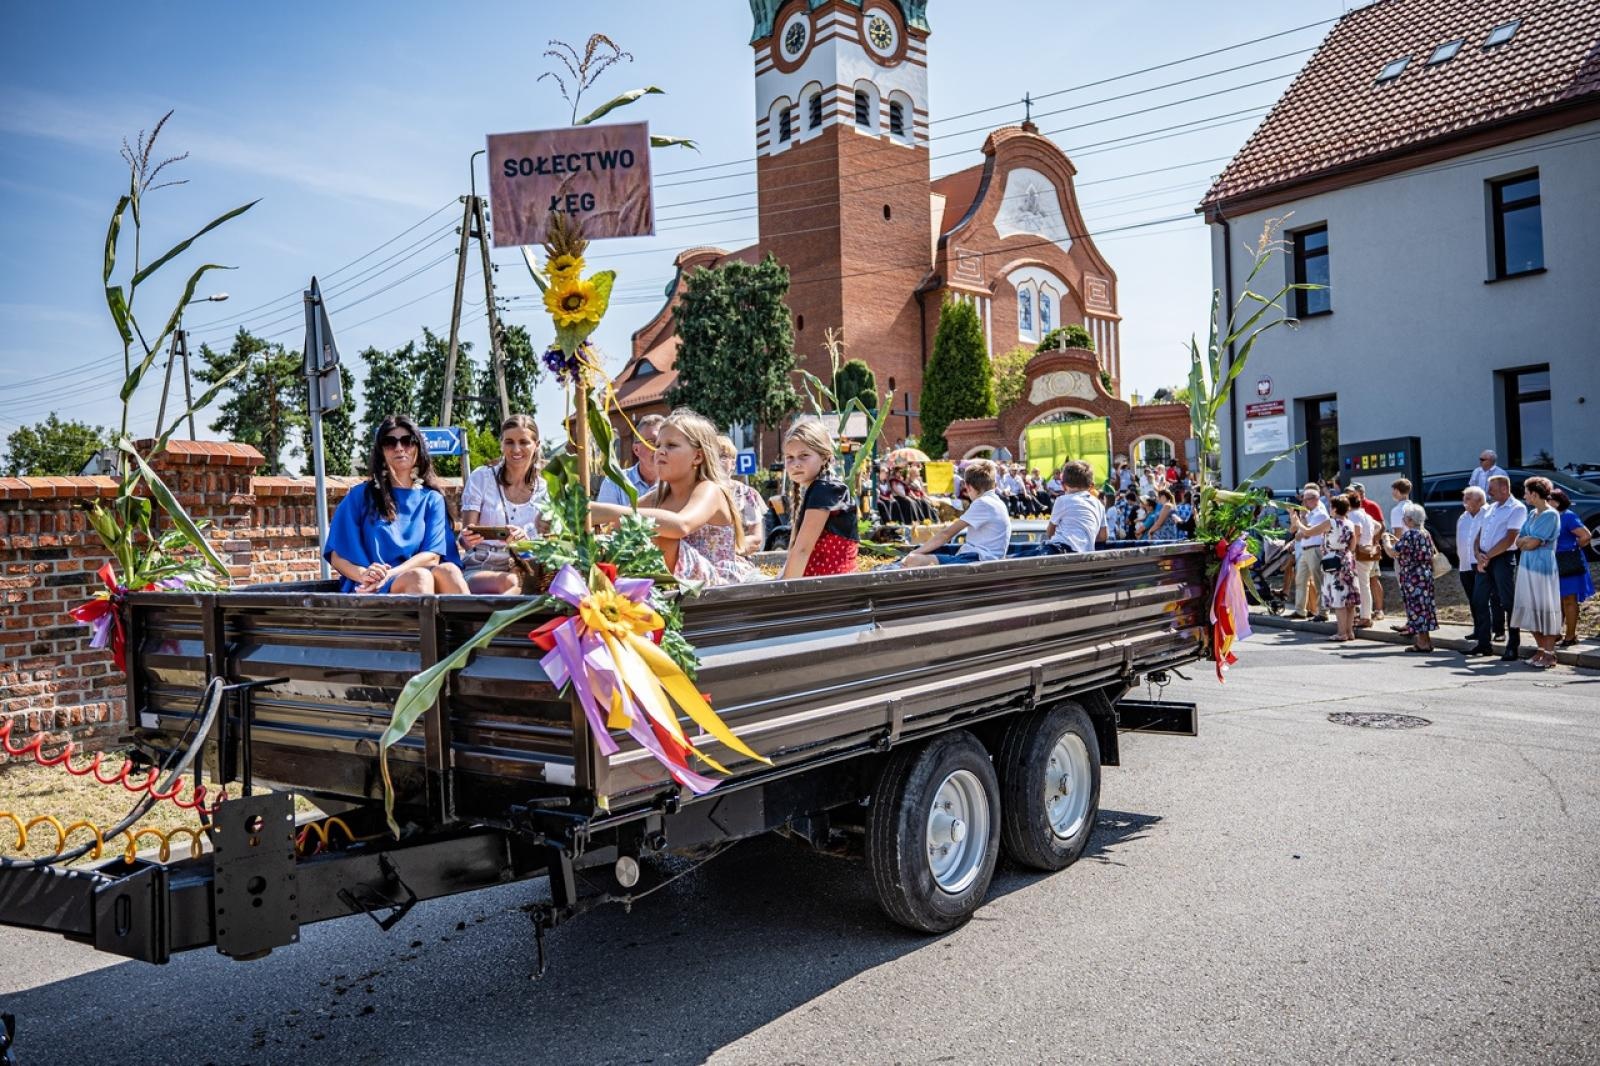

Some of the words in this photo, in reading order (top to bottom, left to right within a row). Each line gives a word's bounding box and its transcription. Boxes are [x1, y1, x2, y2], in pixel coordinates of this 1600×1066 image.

[503, 149, 635, 178] SOŁECTWO
[548, 192, 596, 217] ŁĘG
[740, 455, 752, 472] P
